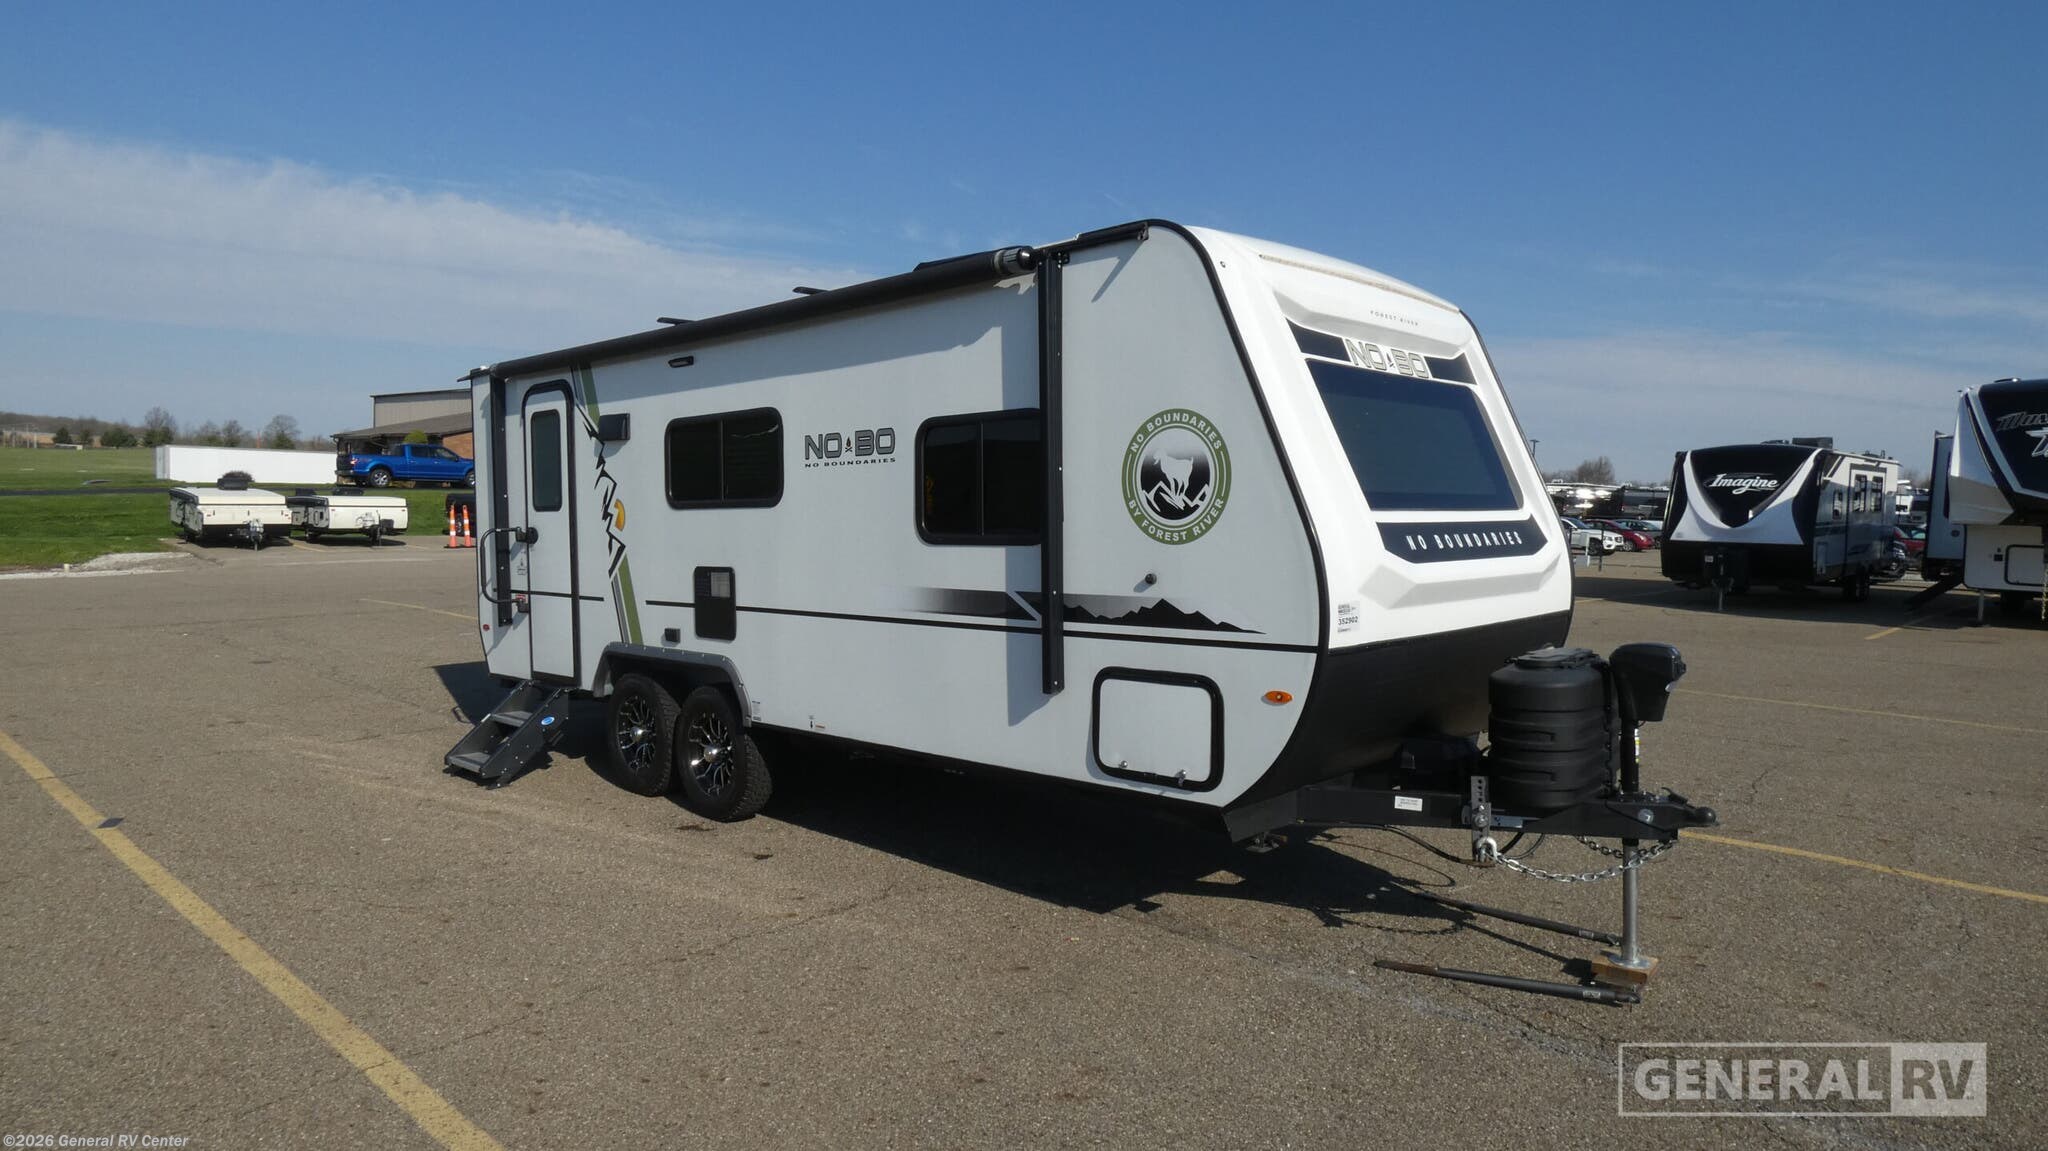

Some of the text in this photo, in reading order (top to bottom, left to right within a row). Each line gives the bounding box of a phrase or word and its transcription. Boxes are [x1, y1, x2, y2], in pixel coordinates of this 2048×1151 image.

[1345, 339, 1429, 378] NO BO
[804, 427, 896, 460] NO BO
[1130, 412, 1222, 452] NO BOUNDARIES
[824, 458, 896, 467] BOUNDARIES
[1708, 473, 1780, 495] Imagine
[1128, 499, 1224, 541] BY FOREST RIVER
[1405, 531, 1523, 550] NO BOUNDARIES
